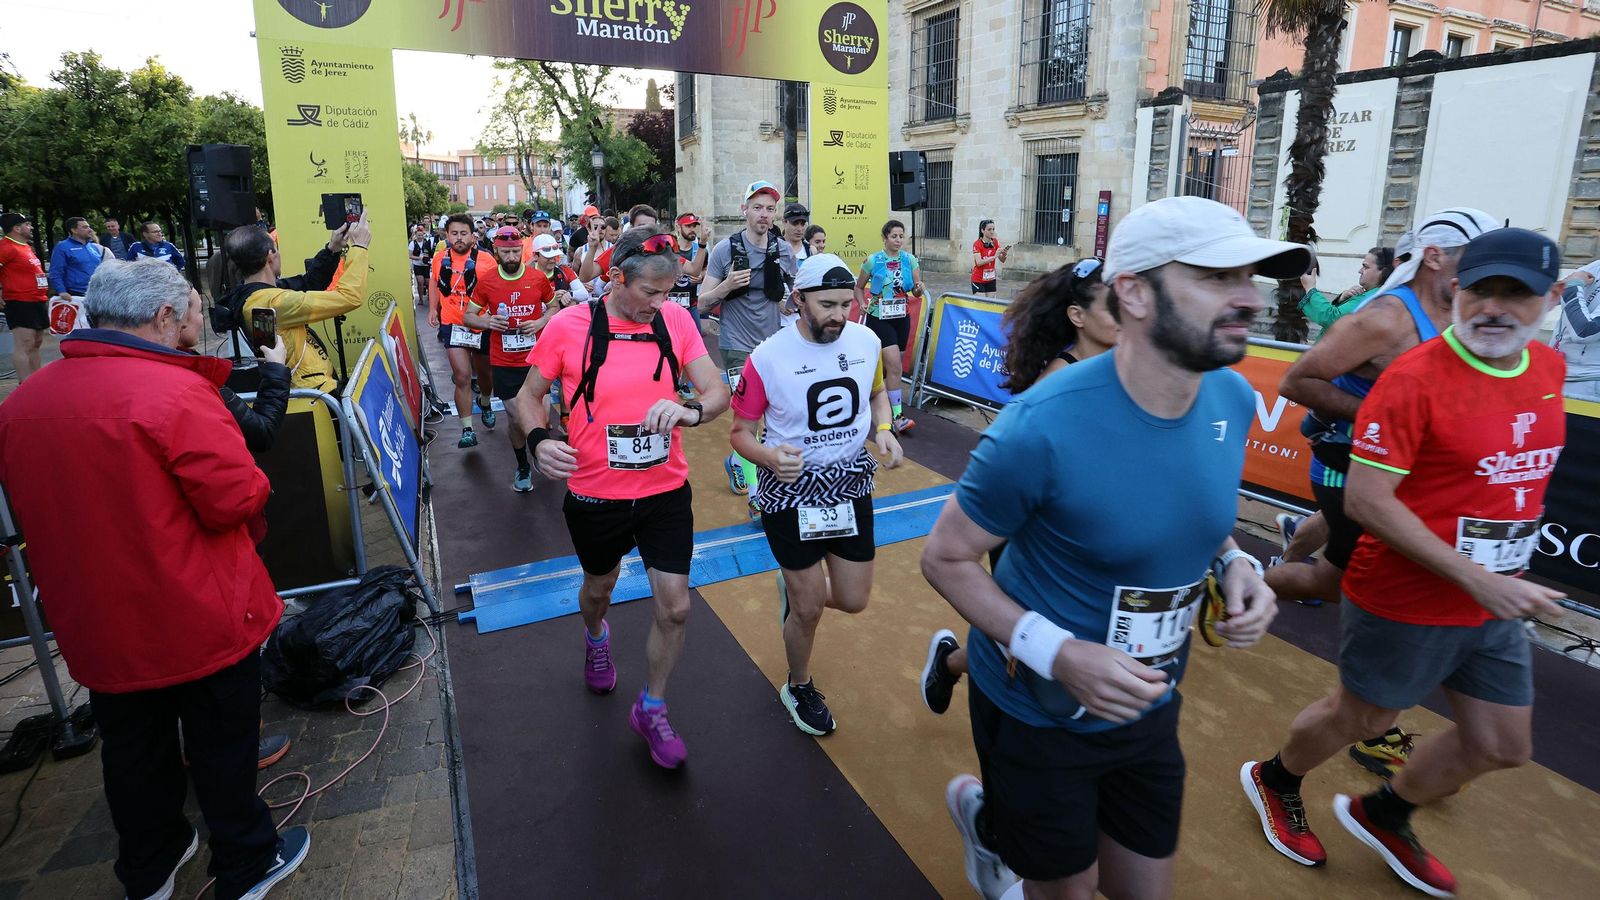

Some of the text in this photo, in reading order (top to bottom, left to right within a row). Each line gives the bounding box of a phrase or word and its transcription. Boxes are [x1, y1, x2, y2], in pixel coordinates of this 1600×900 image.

[576, 17, 671, 44] Maratón
[823, 28, 874, 53] Sherry
[832, 43, 867, 55] Maratón
[310, 59, 374, 71] Ayuntamiento
[325, 69, 347, 77] Jerez
[839, 97, 877, 105] Ayuntamiento
[325, 105, 378, 117] Diputación
[326, 118, 369, 129] de Cádiz
[1327, 110, 1373, 125] AZAR
[845, 130, 877, 140] Diputación
[855, 140, 871, 149] Cádiz
[1327, 139, 1356, 153] REZ
[836, 204, 864, 215] HSN
[506, 303, 535, 313] herry
[889, 304, 900, 312] 116
[514, 335, 525, 344] 15
[979, 356, 991, 369] de
[803, 428, 858, 445] asodena
[632, 437, 652, 454] 84
[1245, 438, 1298, 460] ITION!
[819, 507, 838, 522] 33
[1536, 522, 1600, 568] SC
